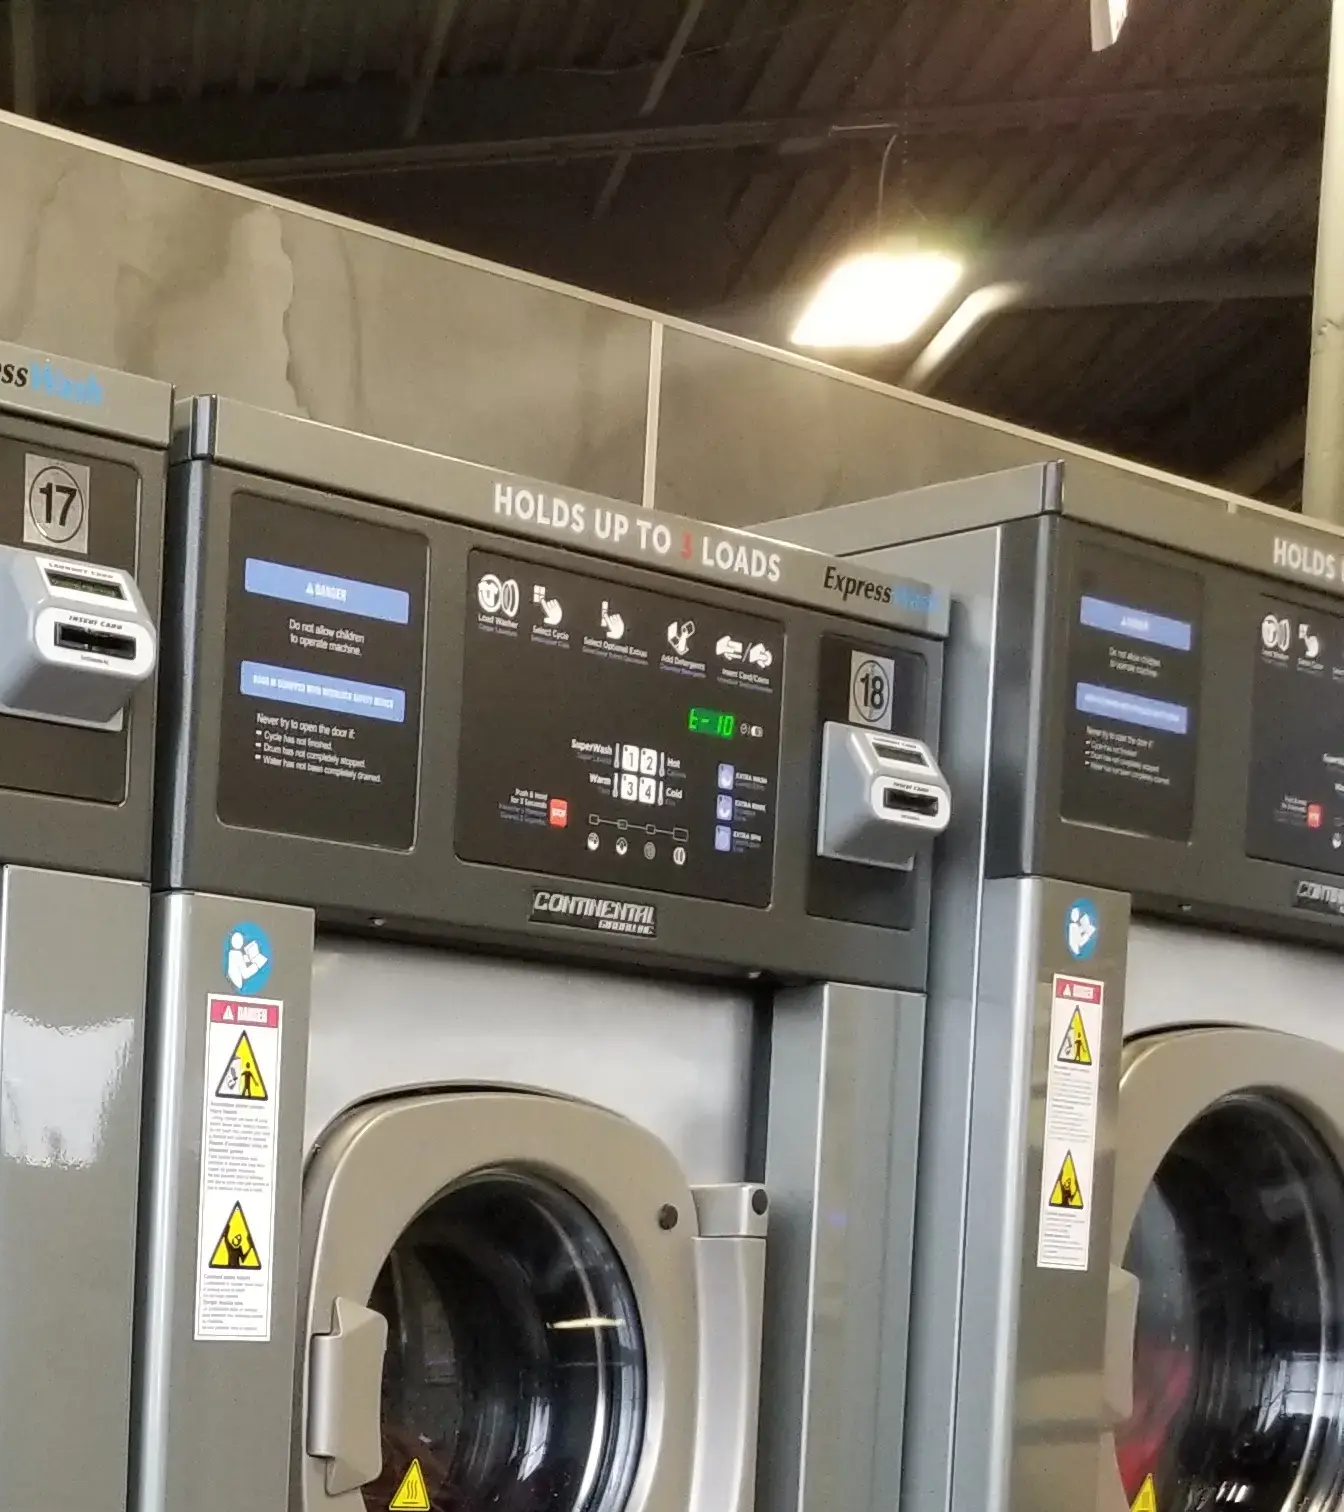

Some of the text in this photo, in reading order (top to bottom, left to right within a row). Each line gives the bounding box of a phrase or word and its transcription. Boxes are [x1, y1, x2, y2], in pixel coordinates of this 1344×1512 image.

[39, 482, 76, 526] 17
[494, 482, 585, 534] HOLDS
[594, 510, 629, 543] UP
[636, 523, 671, 555] TO
[701, 536, 782, 583] LOADS
[1273, 537, 1336, 580] HOLDS
[860, 672, 884, 710] 18
[627, 752, 653, 771] 1 2
[627, 782, 652, 800] 3 4
[666, 788, 682, 799] Cold
[534, 891, 654, 925] CONTINENTAL
